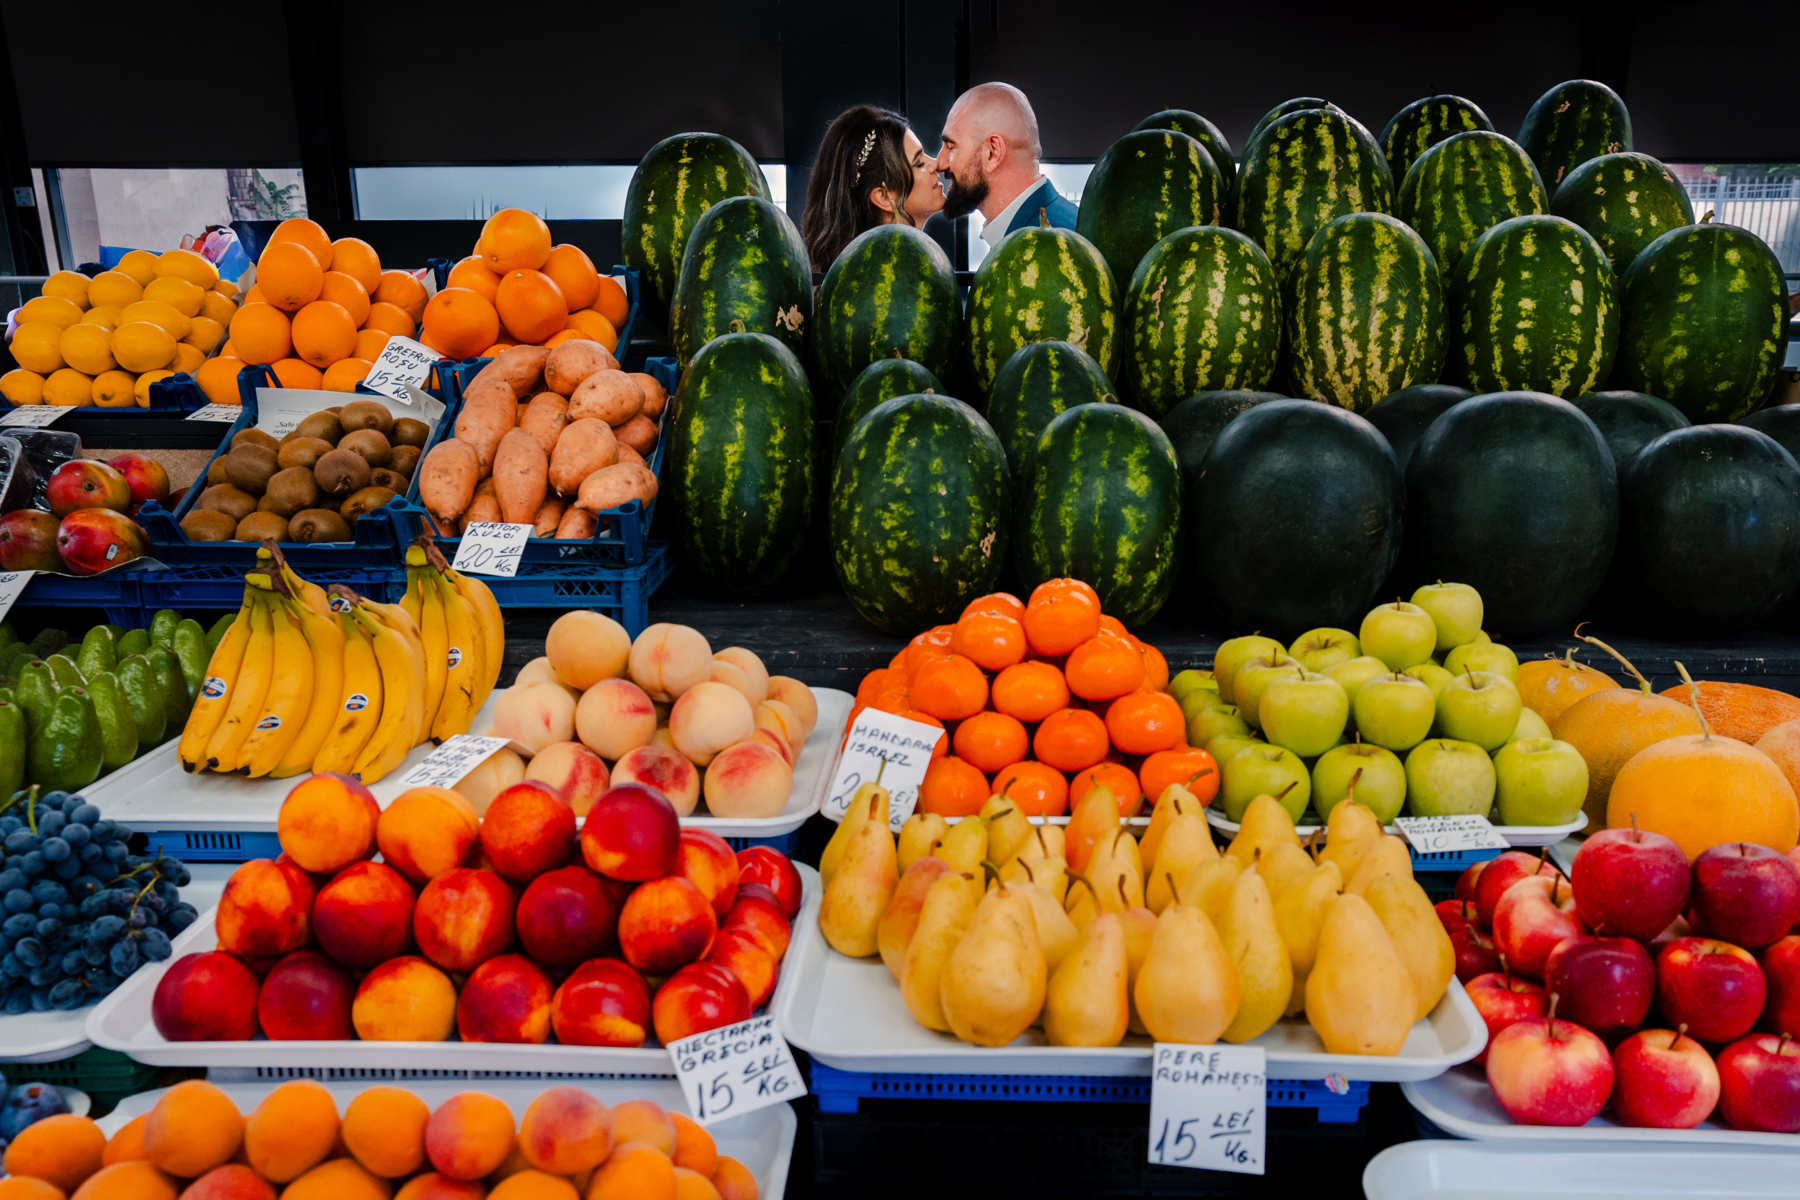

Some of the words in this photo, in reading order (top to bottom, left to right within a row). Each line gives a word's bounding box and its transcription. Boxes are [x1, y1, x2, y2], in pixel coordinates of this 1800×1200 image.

[365, 370, 394, 388] 15
[456, 543, 494, 569] 20
[404, 766, 438, 784] 15
[1423, 835, 1450, 851] 10
[1159, 1049, 1221, 1066] PERE
[698, 1072, 734, 1119] 15
[1155, 1118, 1200, 1164] 15
